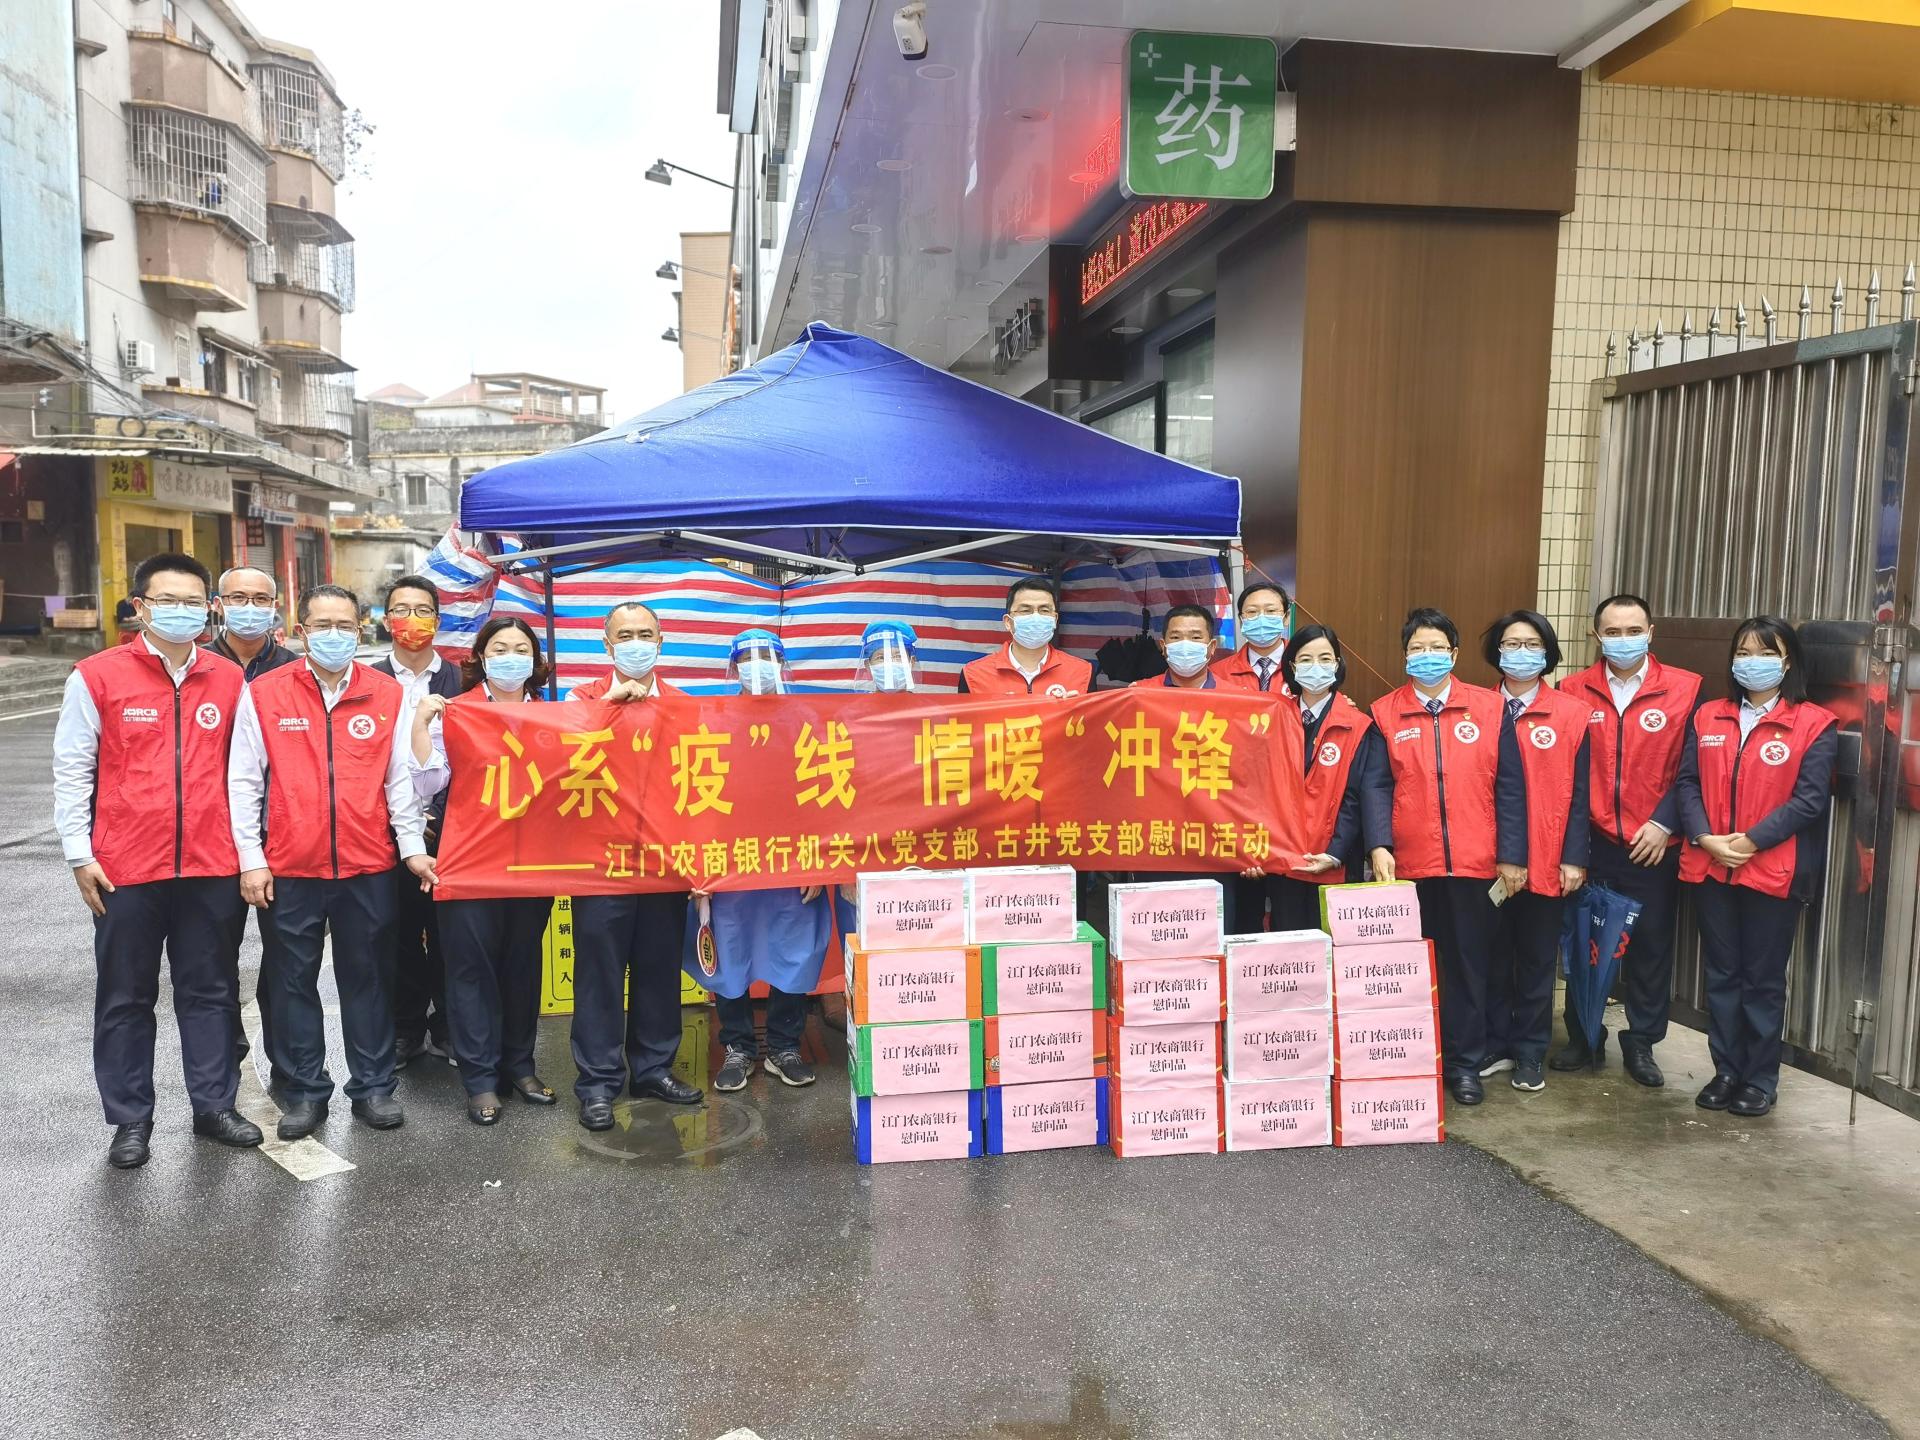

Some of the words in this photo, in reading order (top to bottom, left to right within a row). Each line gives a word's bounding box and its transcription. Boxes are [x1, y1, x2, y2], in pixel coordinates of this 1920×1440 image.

[1154, 64, 1252, 170] 药
[480, 720, 858, 821] 心系“疫”线
[913, 710, 1270, 807] 情暖“冲锋”
[877, 899, 951, 913] 江门农商银行
[986, 894, 1060, 907] 江门农商银行
[1005, 913, 1041, 925] 慰问品
[1132, 909, 1206, 924] 江门农商银行
[1338, 904, 1410, 920] 江门农商银行
[896, 918, 933, 931] 慰问品
[1358, 924, 1393, 937] 慰问品
[1152, 928, 1188, 941] 慰问品
[1008, 963, 1081, 978] 江门农商银行
[1243, 962, 1315, 977] 江门农商银行
[1345, 963, 1418, 978] 江门农商银行
[879, 972, 954, 986] 江门农商银行
[1133, 979, 1207, 993] 江门农商银行
[1027, 982, 1063, 995] 慰问品
[1262, 980, 1299, 994] 慰问品
[1365, 982, 1401, 995] 慰问品
[898, 991, 936, 1004] 慰问品
[1153, 998, 1190, 1011] 慰问品
[1009, 1032, 1082, 1048] 江门农商银行
[1244, 1030, 1317, 1045] 江门农商银行
[1350, 1028, 1423, 1043] 江门农商银行
[883, 1043, 958, 1059] 江门农商银行
[1130, 1040, 1204, 1055] 江门农商银行
[1369, 1047, 1406, 1060] 慰问品
[1029, 1050, 1064, 1064] 慰问品
[1263, 1049, 1299, 1061] 慰问品
[903, 1062, 940, 1076] 慰问品
[1150, 1059, 1186, 1072] 慰问品
[1013, 1100, 1084, 1117] 江门农商银行
[1241, 1099, 1314, 1115] 江门农商银行
[1352, 1099, 1426, 1114] 江门农商银行
[882, 1112, 957, 1127] 江门农商银行
[1132, 1109, 1206, 1124] 江门农商银行
[1032, 1119, 1067, 1133] 慰问品
[1261, 1118, 1297, 1132] 慰问品
[1371, 1118, 1408, 1131] 慰问品
[902, 1131, 938, 1144] 慰问品
[1152, 1128, 1188, 1140] 慰问品
